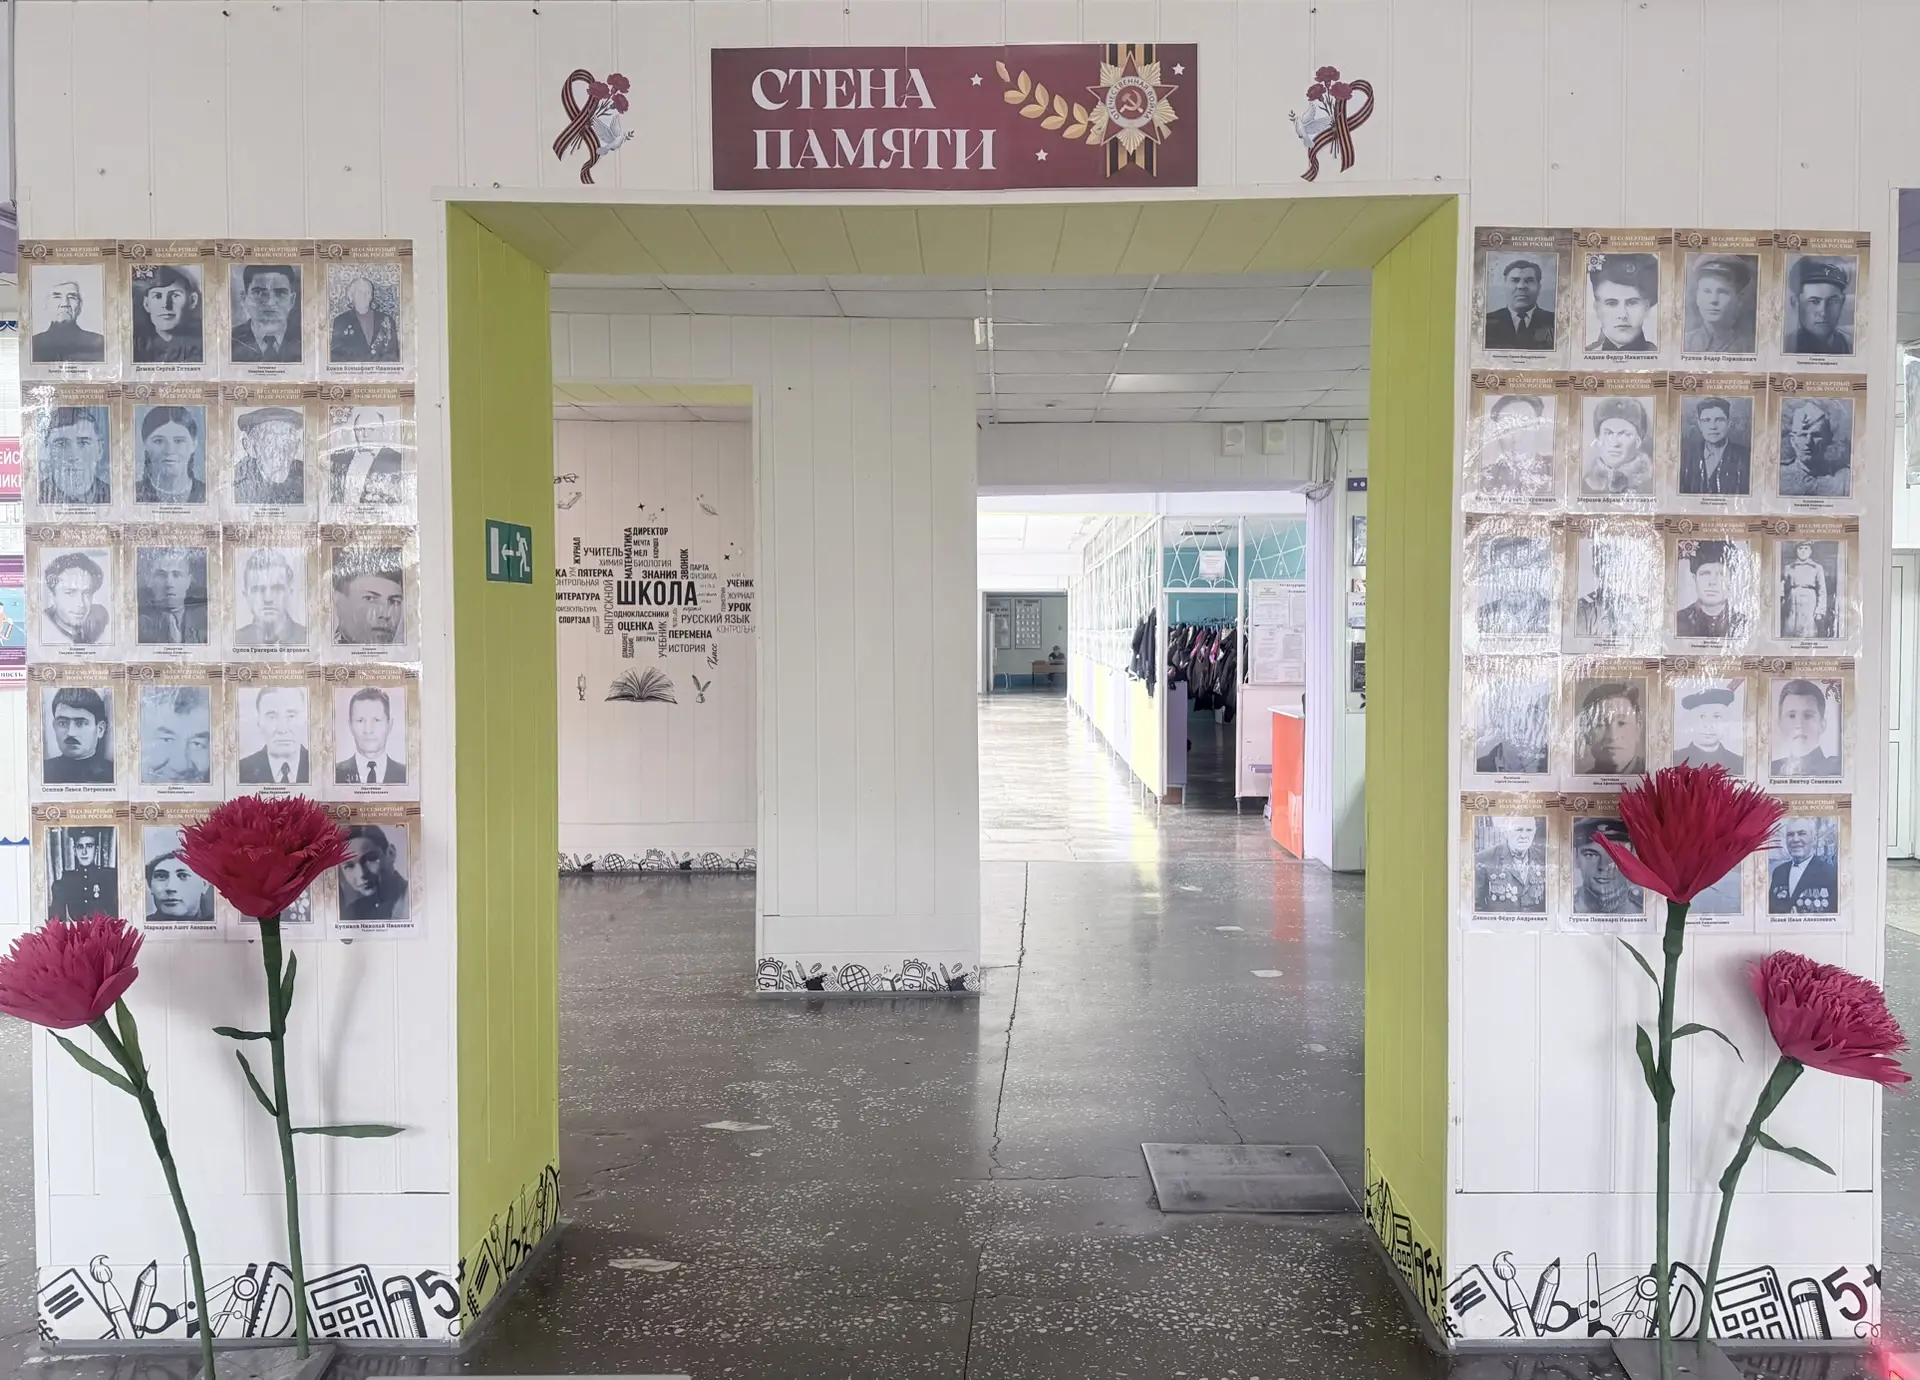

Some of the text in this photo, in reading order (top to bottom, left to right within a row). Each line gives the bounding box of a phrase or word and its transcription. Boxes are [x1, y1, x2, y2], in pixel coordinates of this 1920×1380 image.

[751, 68, 937, 111] СТЕНА
[1109, 78, 1156, 121] ОТЕЧЕСТВЕННАЯ ВОЙНА
[752, 127, 997, 170] ПАМЯТИ
[633, 527, 668, 536] ДИРЕКТОР
[583, 547, 624, 557] УЧИТЕЛЬ
[624, 527, 632, 580] МАТЕМАТИКА
[634, 560, 672, 568] БИОЛОГИЯ
[680, 548, 688, 580] ЗВОНОК
[556, 569, 568, 578] КА
[578, 569, 614, 578] ПЯТЕРКА
[642, 570, 678, 579] ЗНАНИЯ
[690, 572, 718, 580] ФИЗИКА
[726, 580, 754, 588] УЧЕНИК
[617, 580, 698, 606] ШКОЛА
[603, 580, 614, 635] ВЫПУСКНОЙ
[728, 602, 752, 612] УРОК
[614, 610, 670, 618] ОДНОКЛАССНИКИ
[681, 613, 750, 624] РУССКИЙ ЯЗЫК
[558, 616, 591, 624] СПОРТЗАЛ
[618, 622, 654, 632] ОЦЕНКА
[658, 620, 667, 658] УЧЕБНИК
[668, 630, 712, 639] ПЕРЕМЕНА
[668, 644, 706, 653] ИСТОРИЯ
